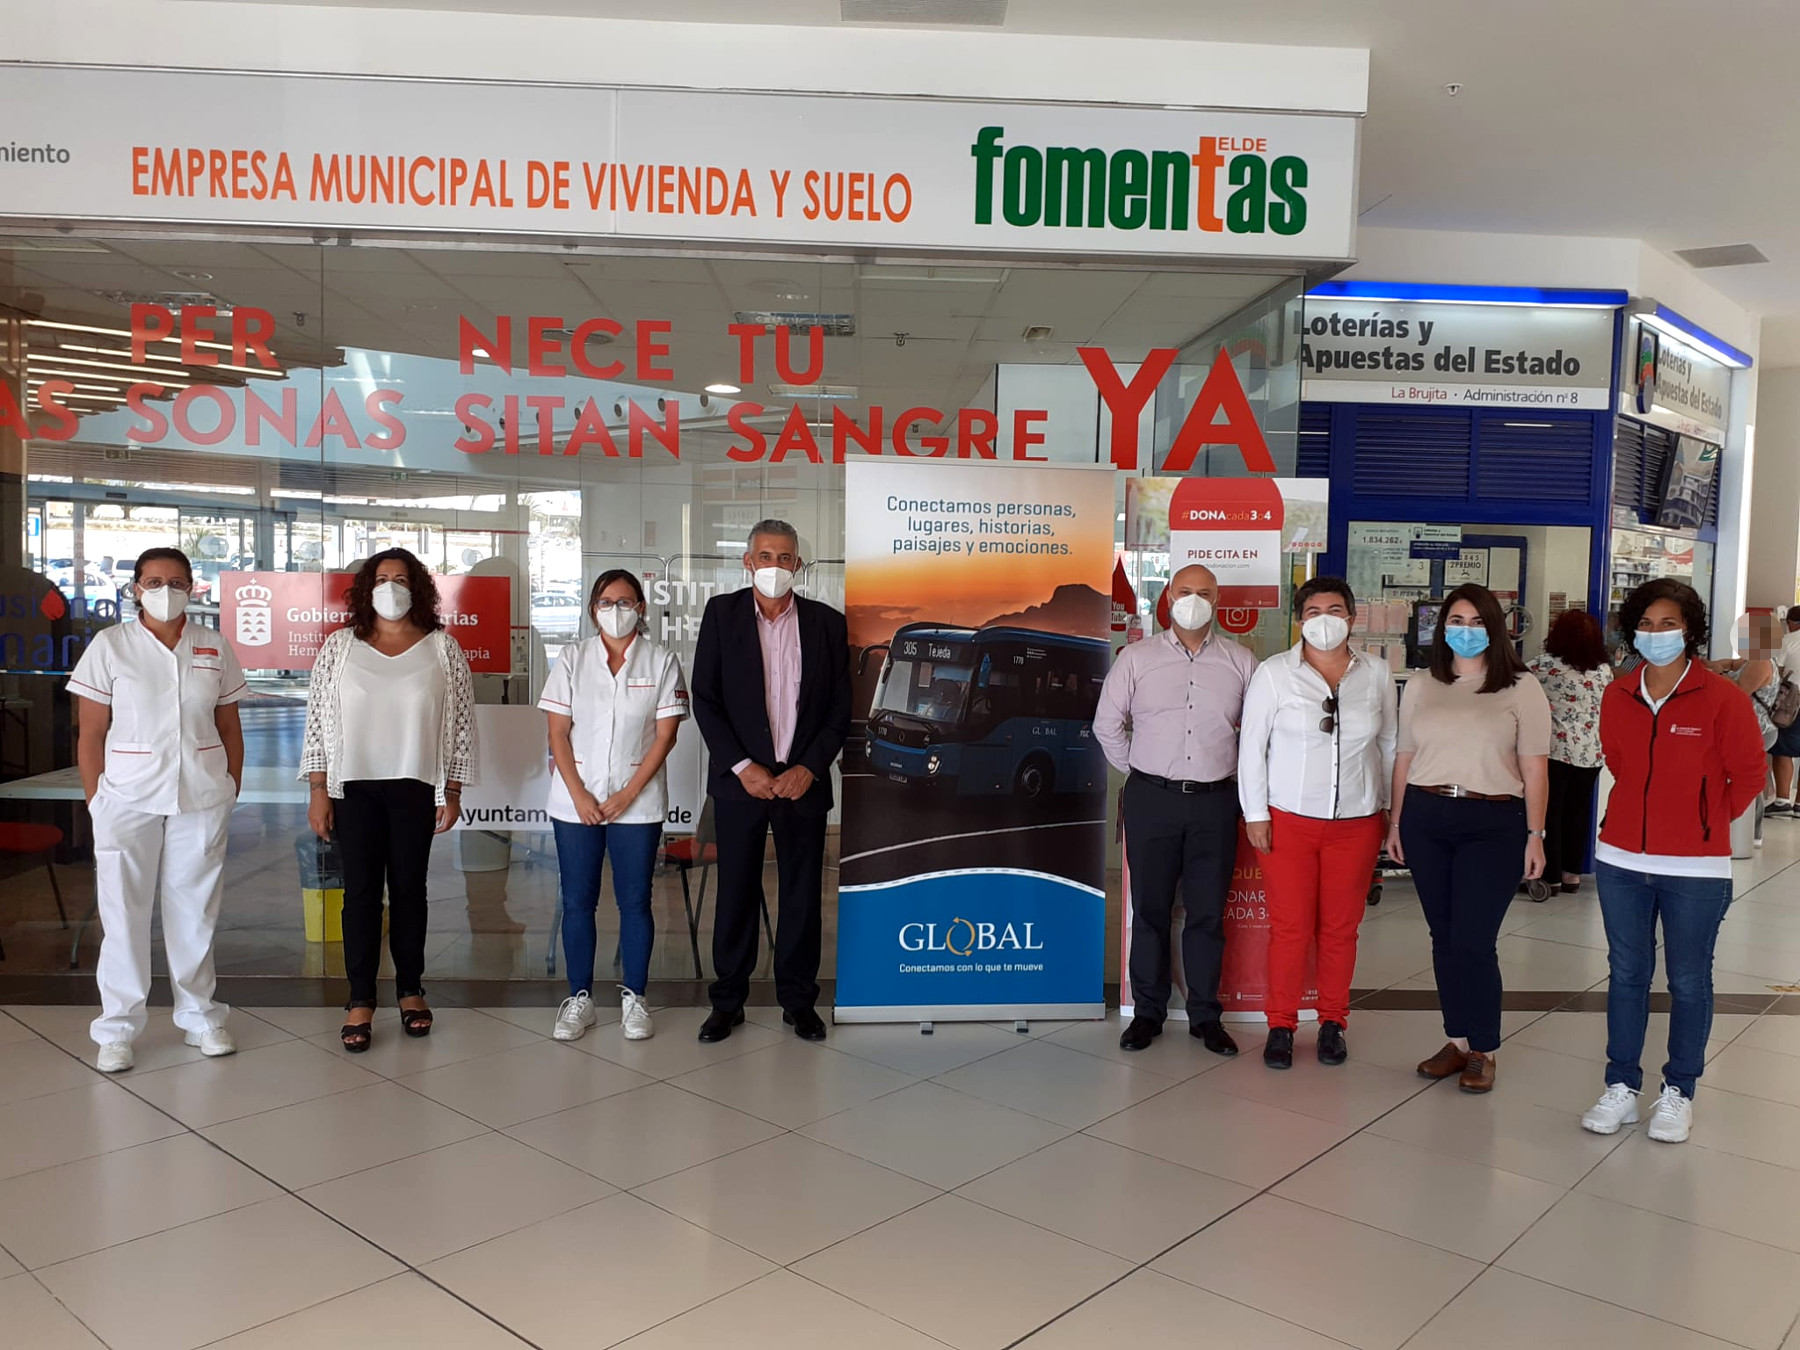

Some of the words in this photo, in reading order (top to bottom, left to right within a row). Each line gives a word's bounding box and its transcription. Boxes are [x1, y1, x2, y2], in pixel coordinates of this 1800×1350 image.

[131, 146, 298, 200] EMPRESA
[309, 153, 513, 208] MUNICIPAL
[527, 160, 570, 209] DE
[582, 161, 757, 217] VIVIENDA
[769, 169, 791, 218] Y
[802, 170, 912, 223] SUELO
[971, 126, 1308, 236] fomentas
[130, 303, 281, 368] PER
[459, 314, 674, 381] NECE
[728, 323, 824, 386] TU
[1294, 311, 1410, 338] Loterías
[1418, 320, 1434, 346] y
[1294, 343, 1426, 374] Apuestas
[1433, 345, 1475, 373] del
[1484, 349, 1581, 376] Estado
[1076, 346, 1278, 473] YA
[1391, 386, 1406, 399] La
[1408, 386, 1447, 402] Brujita
[1463, 389, 1553, 404] Administración
[1570, 391, 1578, 404] 8
[1690, 384, 1701, 412] del
[1701, 391, 1723, 421] Estado
[125, 381, 407, 450] SONAS
[453, 393, 680, 460] SITAN
[726, 402, 1049, 464] SANGRE
[886, 495, 992, 515] Conectamos
[996, 501, 1077, 519] personas,
[908, 516, 974, 536] lugares,
[978, 518, 1056, 537] historias,
[893, 536, 962, 556] paisajes
[966, 541, 974, 556] y
[978, 538, 1073, 555] emociones.
[1187, 549, 1212, 559] PIDE
[1214, 549, 1240, 559] CITA
[1242, 549, 1258, 559] EN
[1112, 600, 1125, 610] You
[903, 641, 917, 656] 305
[928, 643, 951, 659] Tejeda
[898, 917, 1044, 957] GLOBAL
[899, 963, 955, 973] Conectamos
[975, 963, 984, 972] lo
[985, 964, 1001, 974] que
